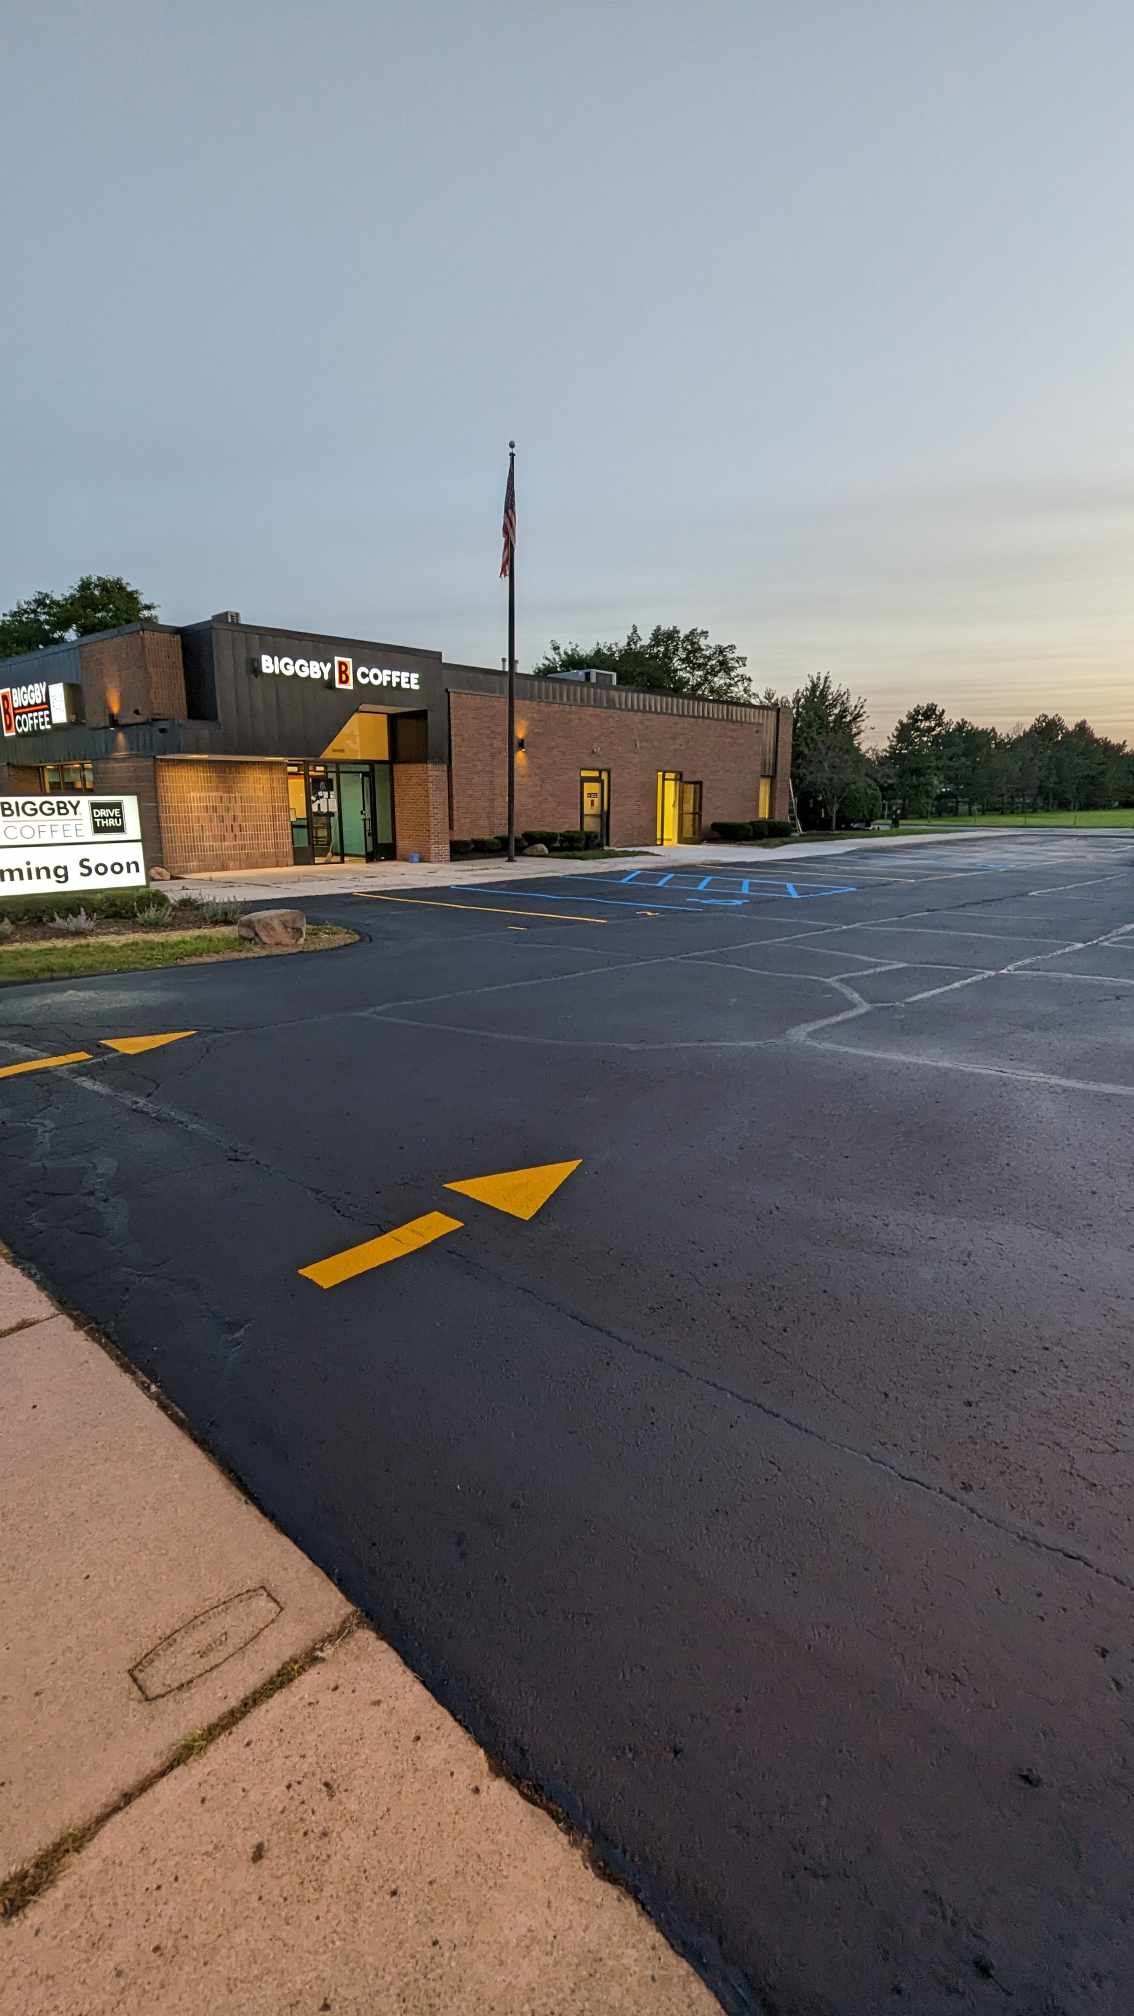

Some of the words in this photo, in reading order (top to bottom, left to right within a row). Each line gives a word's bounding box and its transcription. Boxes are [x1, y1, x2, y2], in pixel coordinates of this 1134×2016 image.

[261, 654, 332, 680] BIGGBY
[338, 660, 350, 685] B
[356, 666, 420, 690] COFFEE
[12, 682, 46, 708] BIGGBY
[1, 694, 13, 731] B
[15, 710, 51, 733] COFFEE
[0, 800, 81, 817] BIGGBY
[93, 808, 121, 817] DRIVE
[4, 823, 85, 840] COFFEE
[95, 817, 122, 827] THRU
[79, 857, 140, 877] Soon
